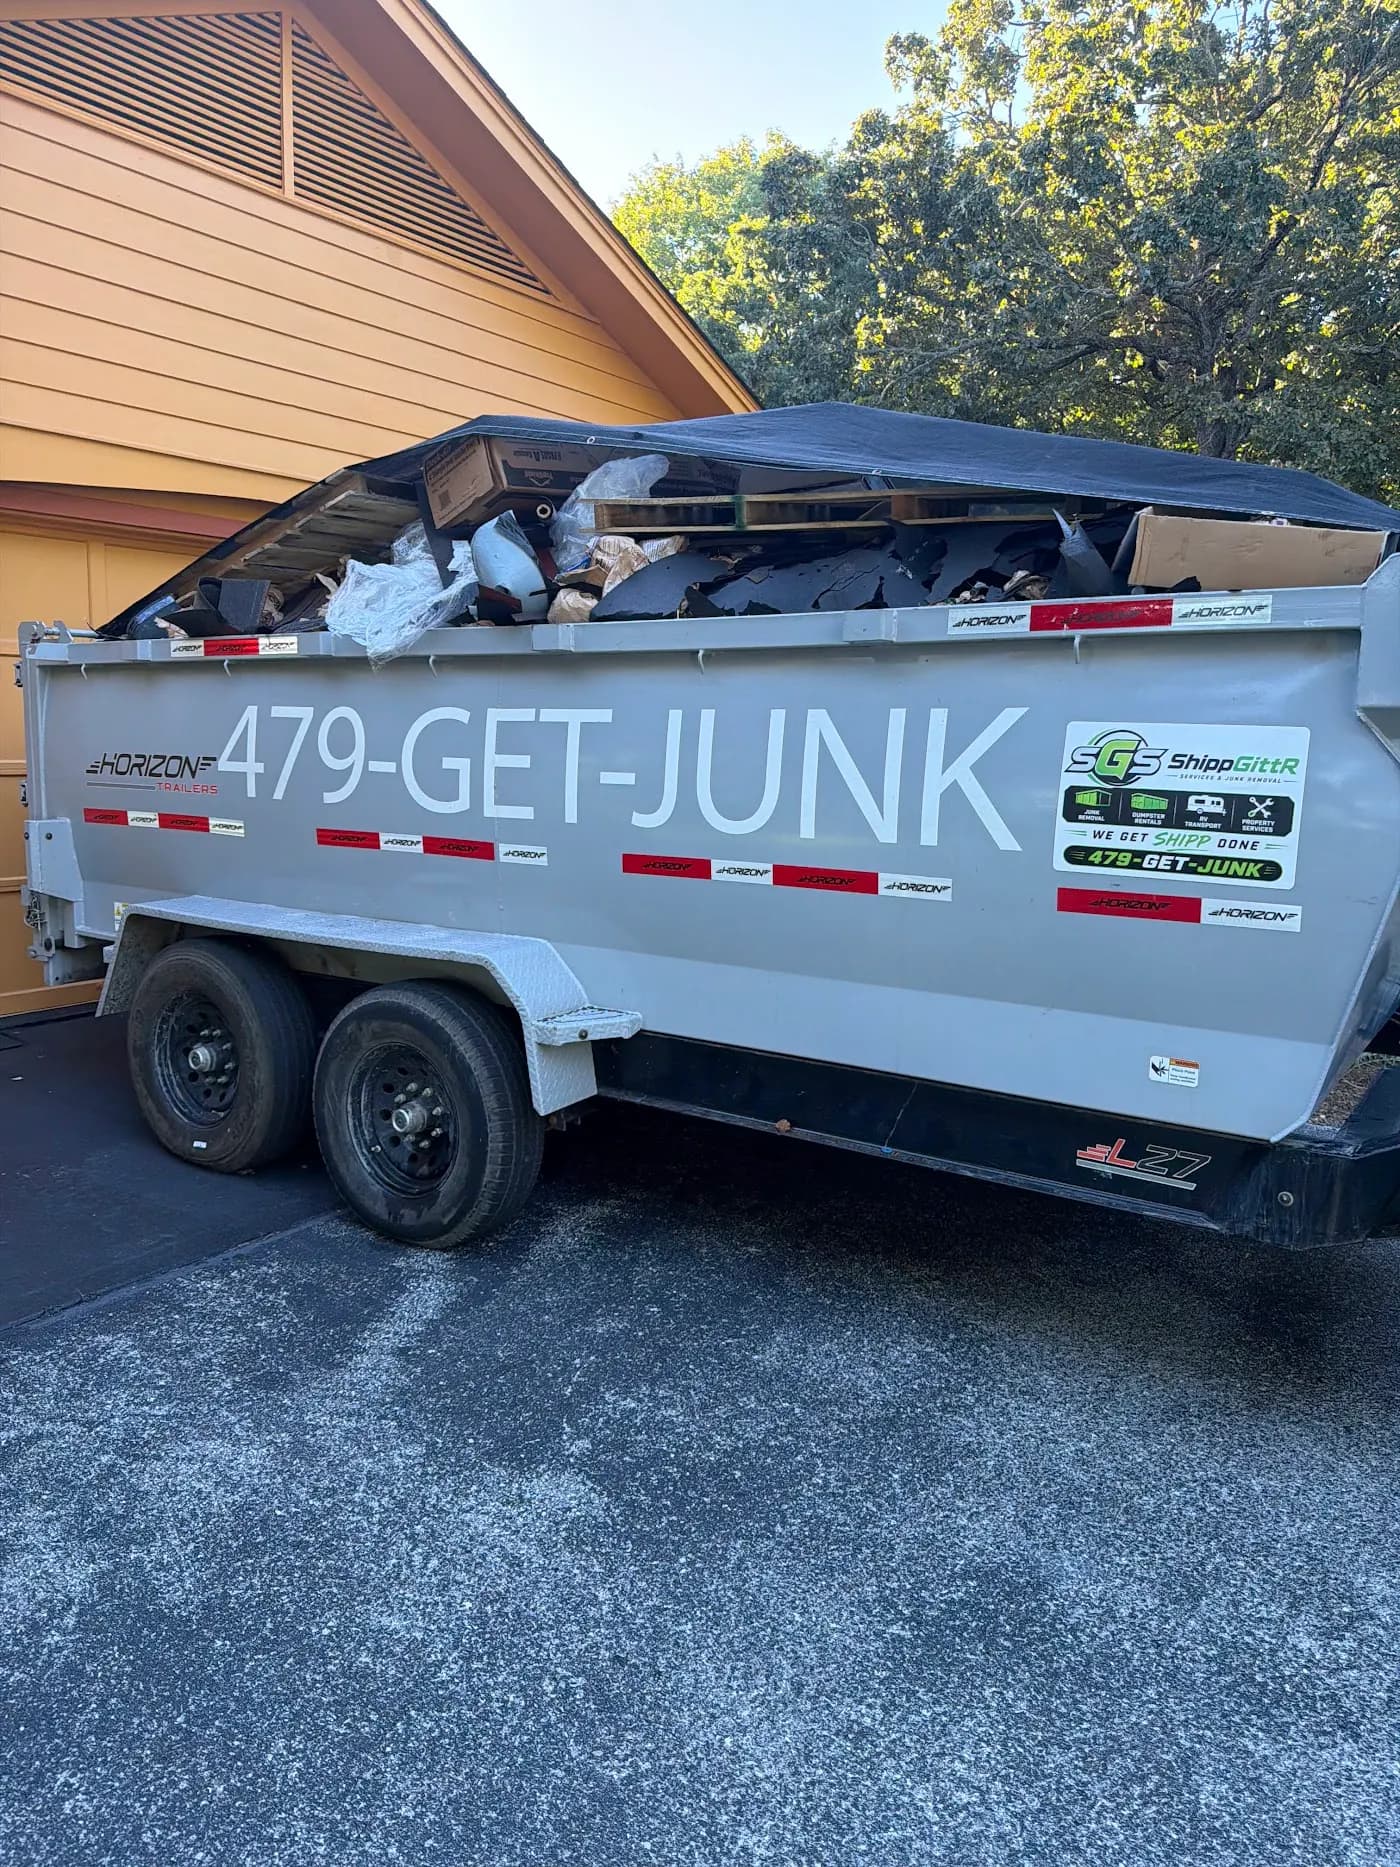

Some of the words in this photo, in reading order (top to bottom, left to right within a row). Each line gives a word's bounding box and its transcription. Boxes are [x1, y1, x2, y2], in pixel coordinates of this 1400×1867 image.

[957, 615, 1022, 628] HORIZON
[1184, 604, 1262, 619] HORIZON
[97, 752, 205, 779] HORIZON
[1064, 738, 1168, 781] SGS
[1167, 753, 1300, 775] ShippGittR
[156, 782, 218, 794] TRAILERS
[217, 705, 1029, 852] 479-GET-JUNK
[1179, 773, 1214, 781] SERVICES
[1078, 814, 1105, 822] REMOVAL
[1132, 812, 1165, 820] DUMPSTER
[1184, 821, 1222, 829] TRANSPORT
[1241, 818, 1275, 827] PROPERTY
[1092, 830, 1113, 841] WE
[1119, 831, 1148, 843] GET
[1152, 831, 1212, 848] SHIPP
[1217, 838, 1260, 850] DONE
[1242, 825, 1273, 833] SERVICES
[386, 838, 420, 847] HORIZON
[505, 849, 545, 860] HORIZON
[1087, 850, 1265, 878] 479-GET-JUNK
[719, 865, 768, 877] HORIZON
[888, 881, 948, 894] HORIZON
[1095, 897, 1166, 911] HORIZON
[1214, 907, 1293, 922] HORIZON
[1106, 1138, 1212, 1178] L27
